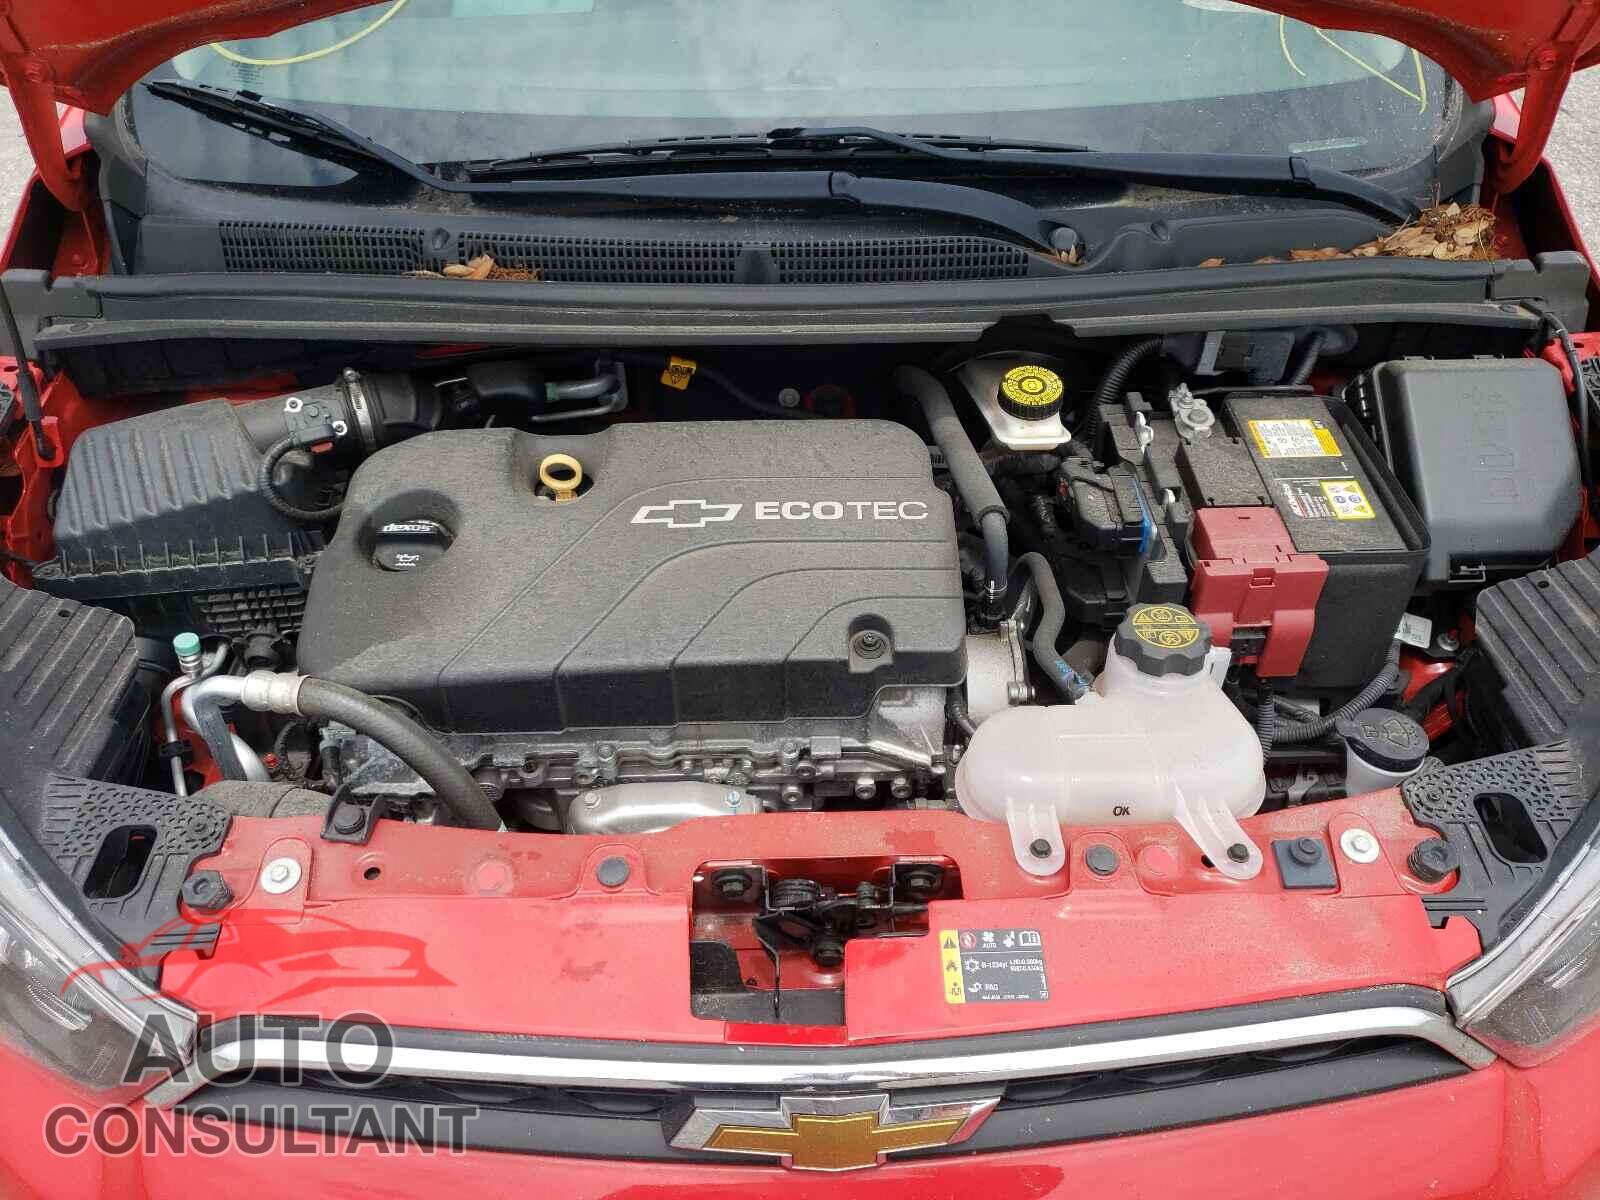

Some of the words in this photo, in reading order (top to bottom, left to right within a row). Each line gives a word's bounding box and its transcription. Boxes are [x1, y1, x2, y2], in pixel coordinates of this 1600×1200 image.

[755, 501, 928, 520] ECOTEC
[382, 523, 433, 532] dexos
[1112, 806, 1131, 817] OK
